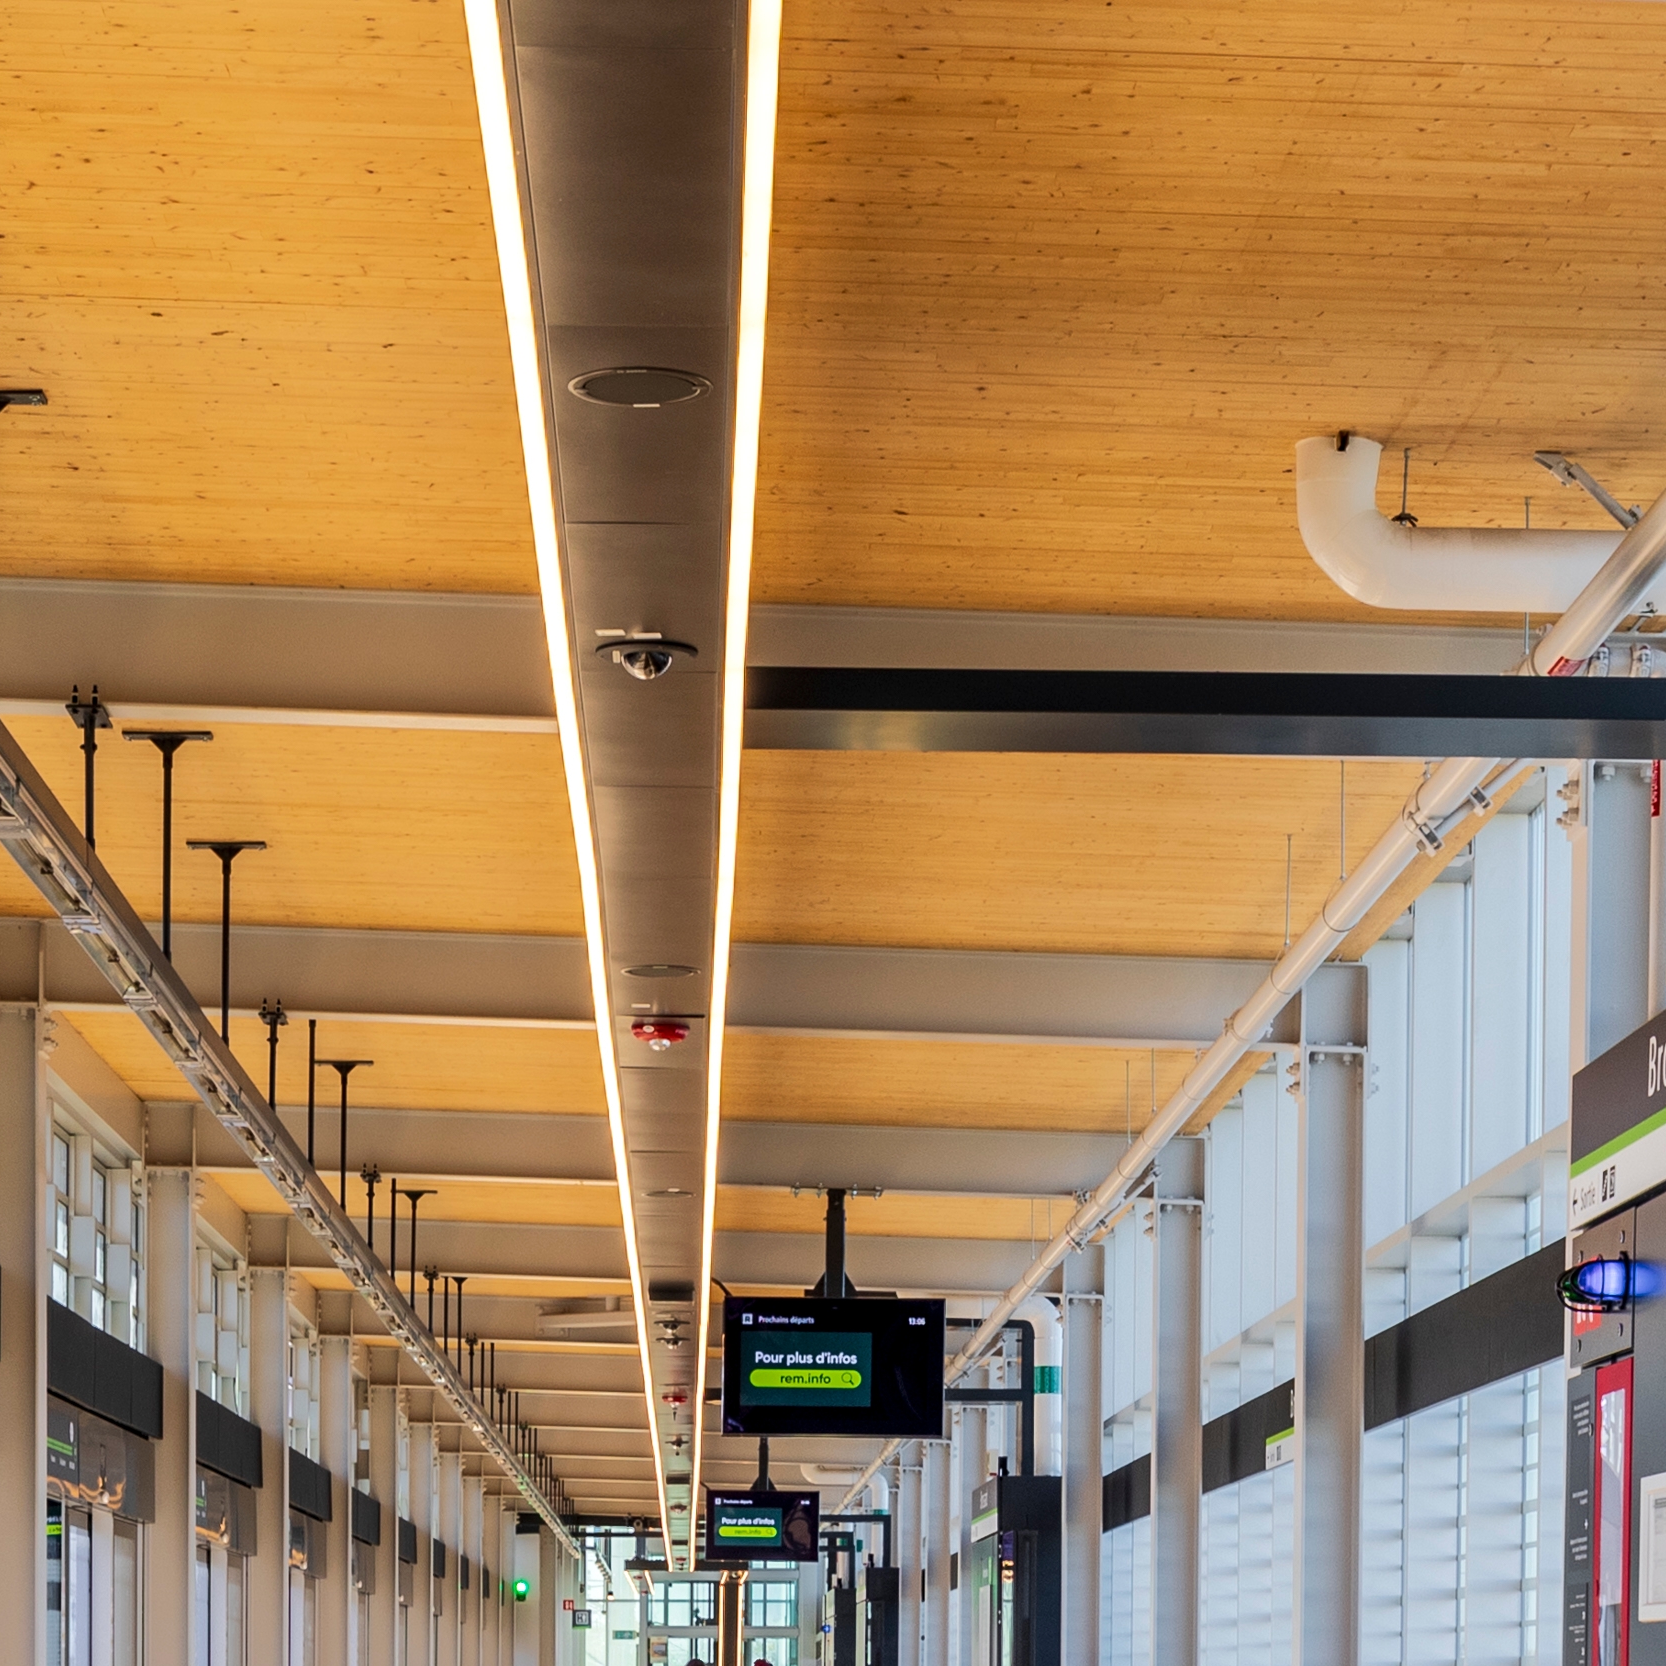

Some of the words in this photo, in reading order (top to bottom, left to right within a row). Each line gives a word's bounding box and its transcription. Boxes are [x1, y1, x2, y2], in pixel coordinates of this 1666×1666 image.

[758, 1315, 789, 1324] Prochains
[789, 1315, 815, 1326] départs
[755, 1351, 784, 1364] Pour
[786, 1351, 813, 1366] plus
[815, 1352, 858, 1365] d'infos
[780, 1373, 831, 1384] rem.info
[721, 1517, 737, 1525] Pour
[737, 1517, 752, 1526] plus
[753, 1517, 775, 1526] d'infos
